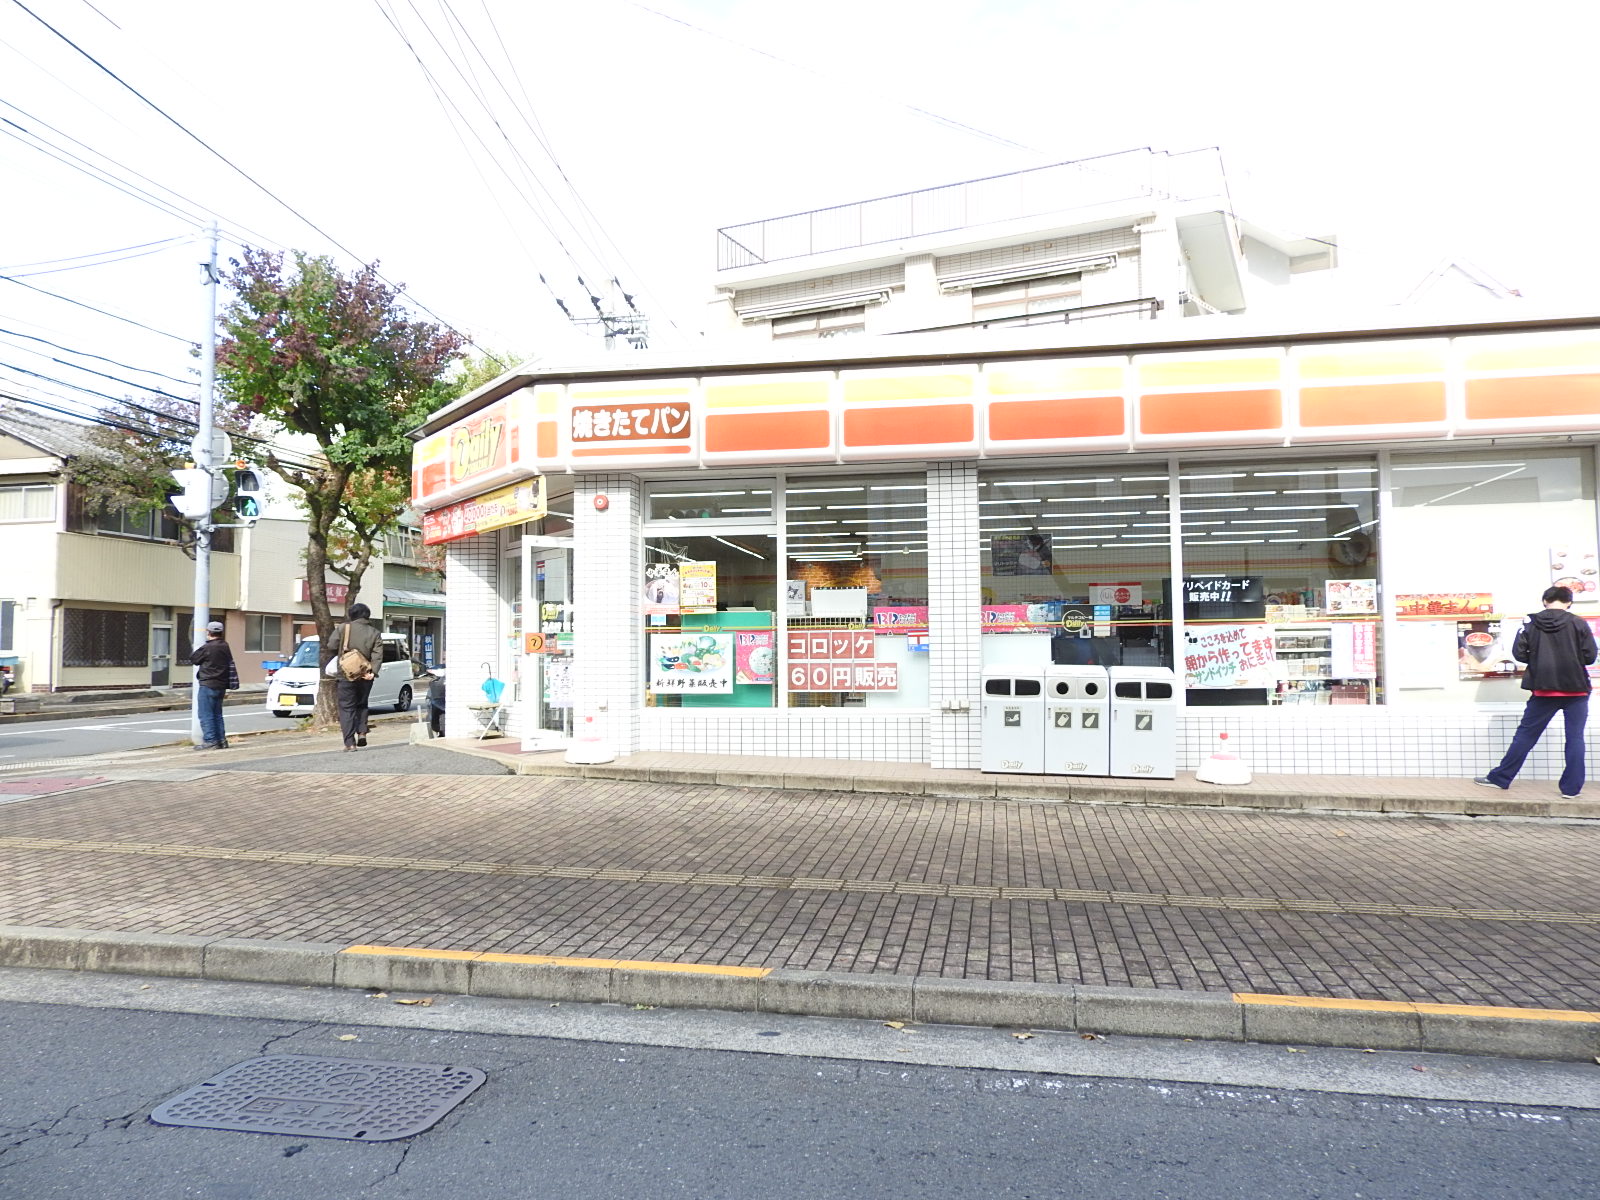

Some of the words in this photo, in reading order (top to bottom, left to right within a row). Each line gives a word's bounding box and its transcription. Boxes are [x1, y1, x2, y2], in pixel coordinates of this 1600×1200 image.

[572, 408, 690, 439] 焼きたてパン
[453, 418, 503, 481] Daily
[1409, 599, 1479, 615] 中華まん
[790, 635, 873, 655] コロッケ
[1200, 628, 1247, 648] こころを込めて
[1184, 636, 1273, 672] 朝から作ってます
[1238, 651, 1275, 671] おにぎり
[655, 677, 729, 689] 新鮮野菜販売中
[791, 666, 897, 687] 60円販売
